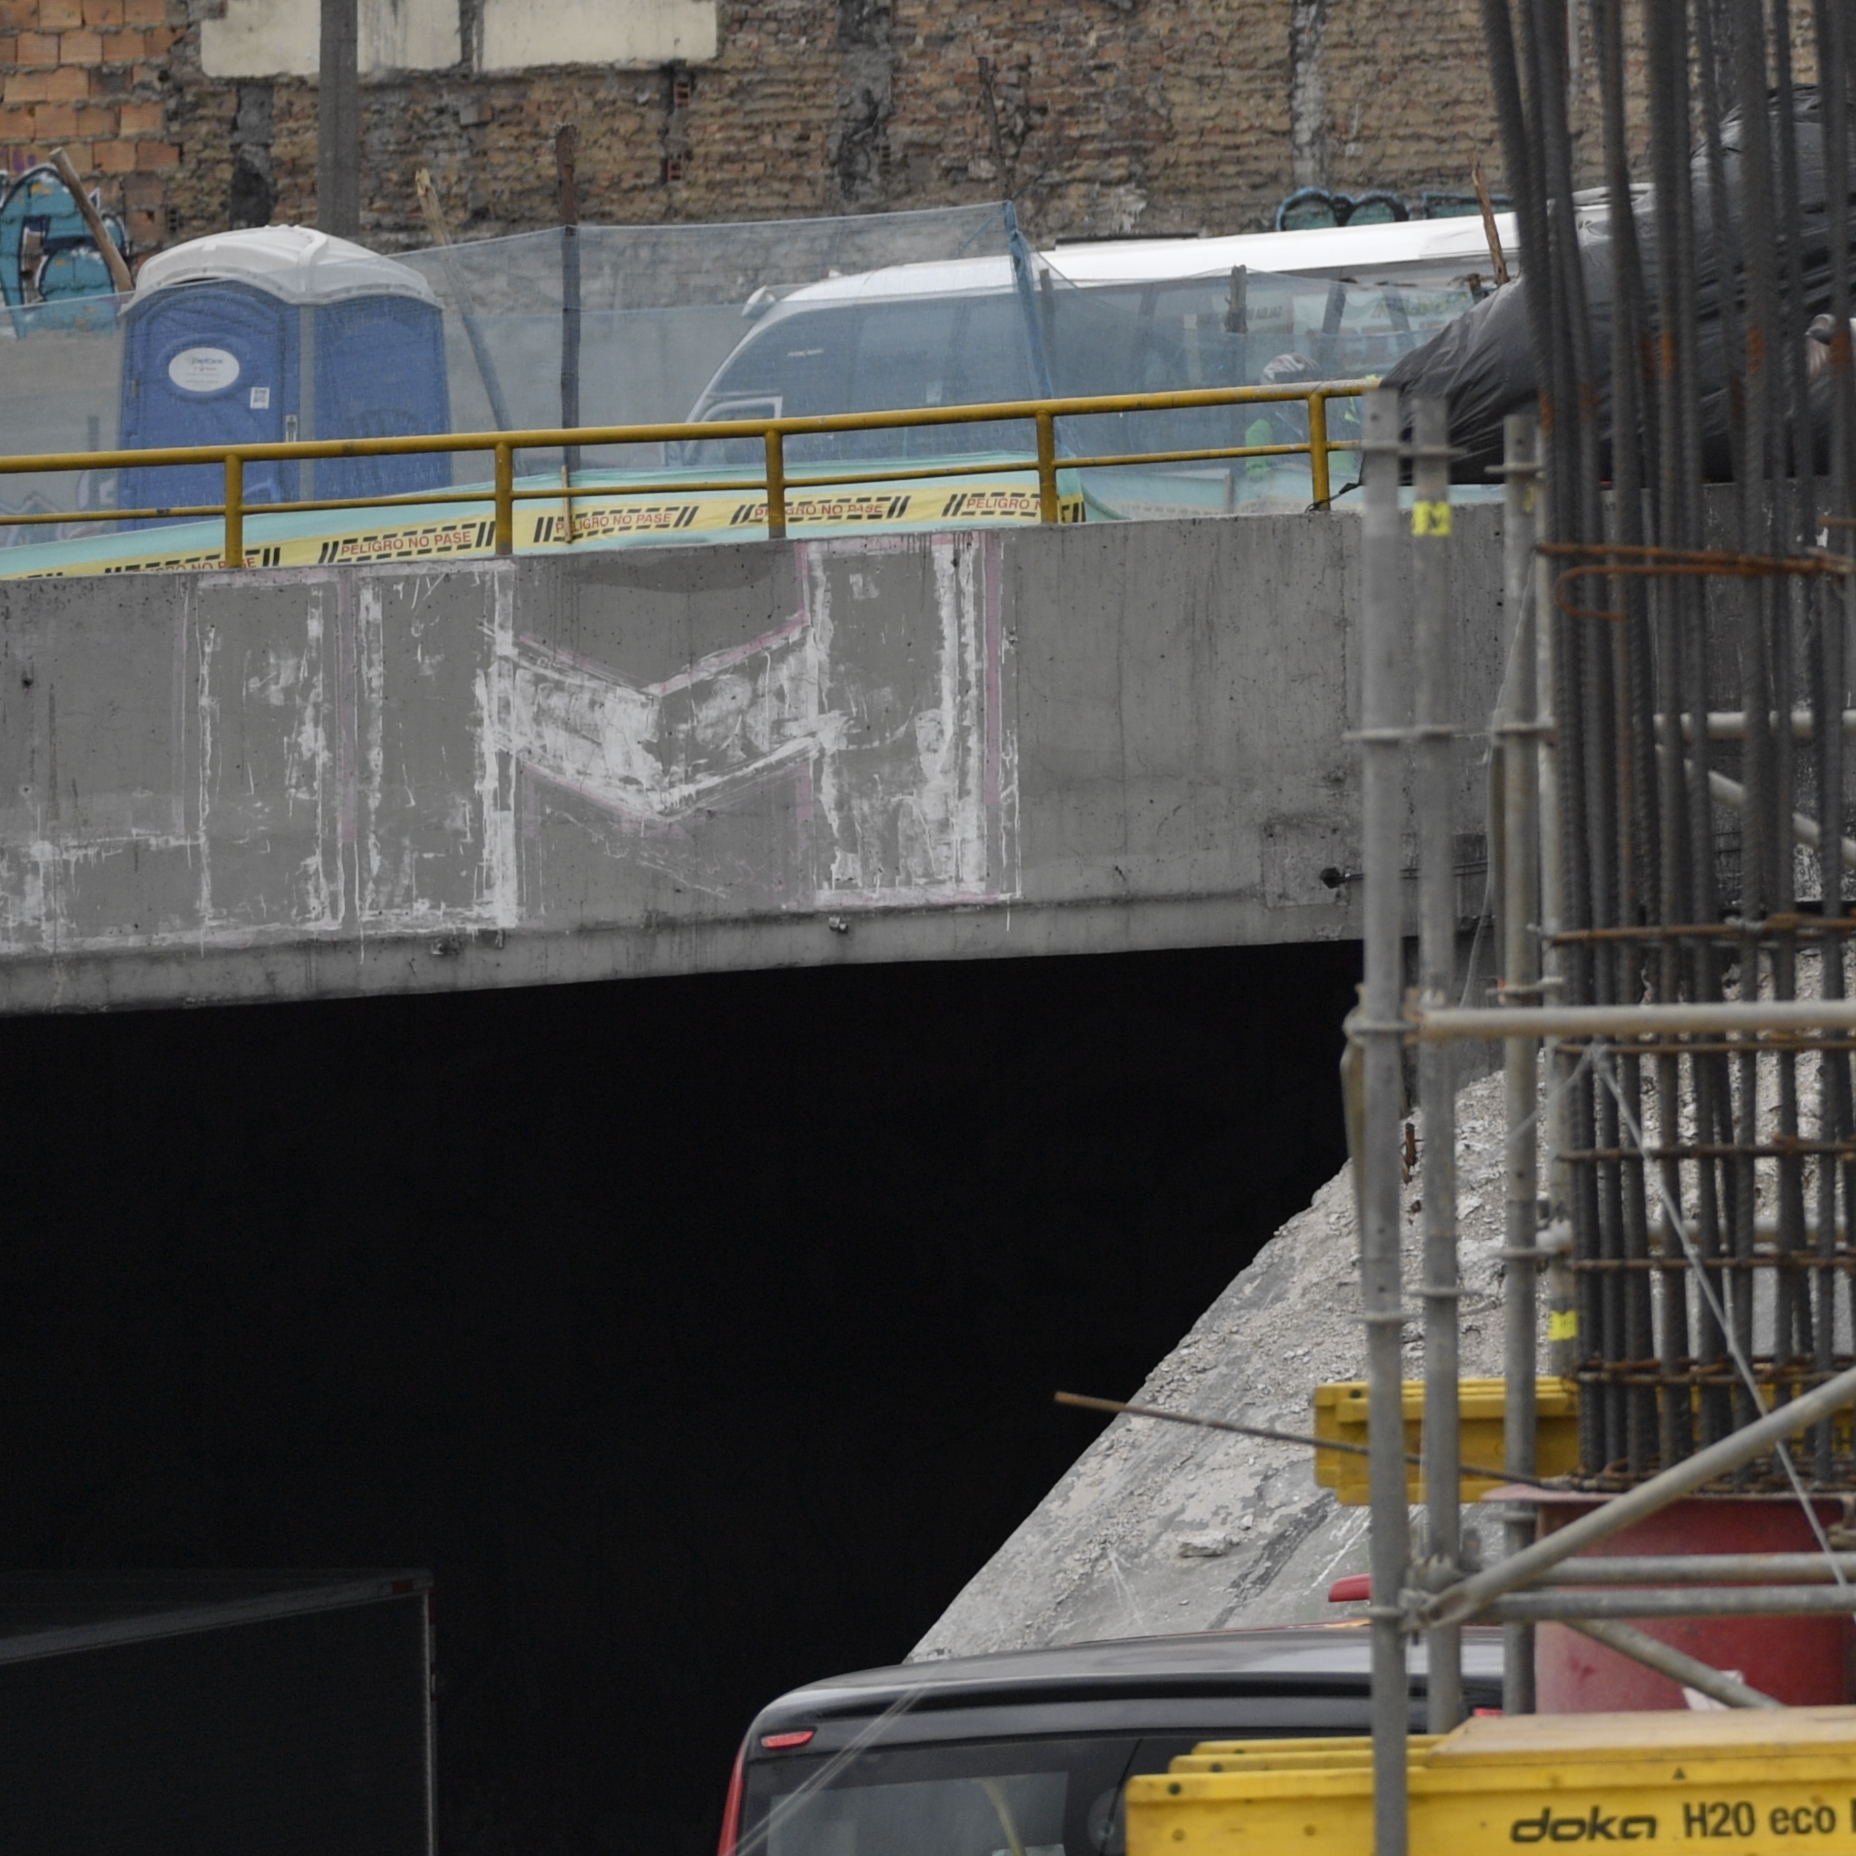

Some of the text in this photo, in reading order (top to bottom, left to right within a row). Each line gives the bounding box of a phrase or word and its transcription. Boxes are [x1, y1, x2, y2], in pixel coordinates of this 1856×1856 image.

[820, 503, 844, 516] NO
[966, 496, 1031, 510] PELIGRO
[613, 515, 633, 526] NO
[636, 512, 672, 525] PASE
[340, 530, 473, 556] PELIGRO NO PASE
[1509, 1804, 1657, 1844] doka
[1684, 1801, 1756, 1838] H20
[1769, 1803, 1836, 1835] eco
